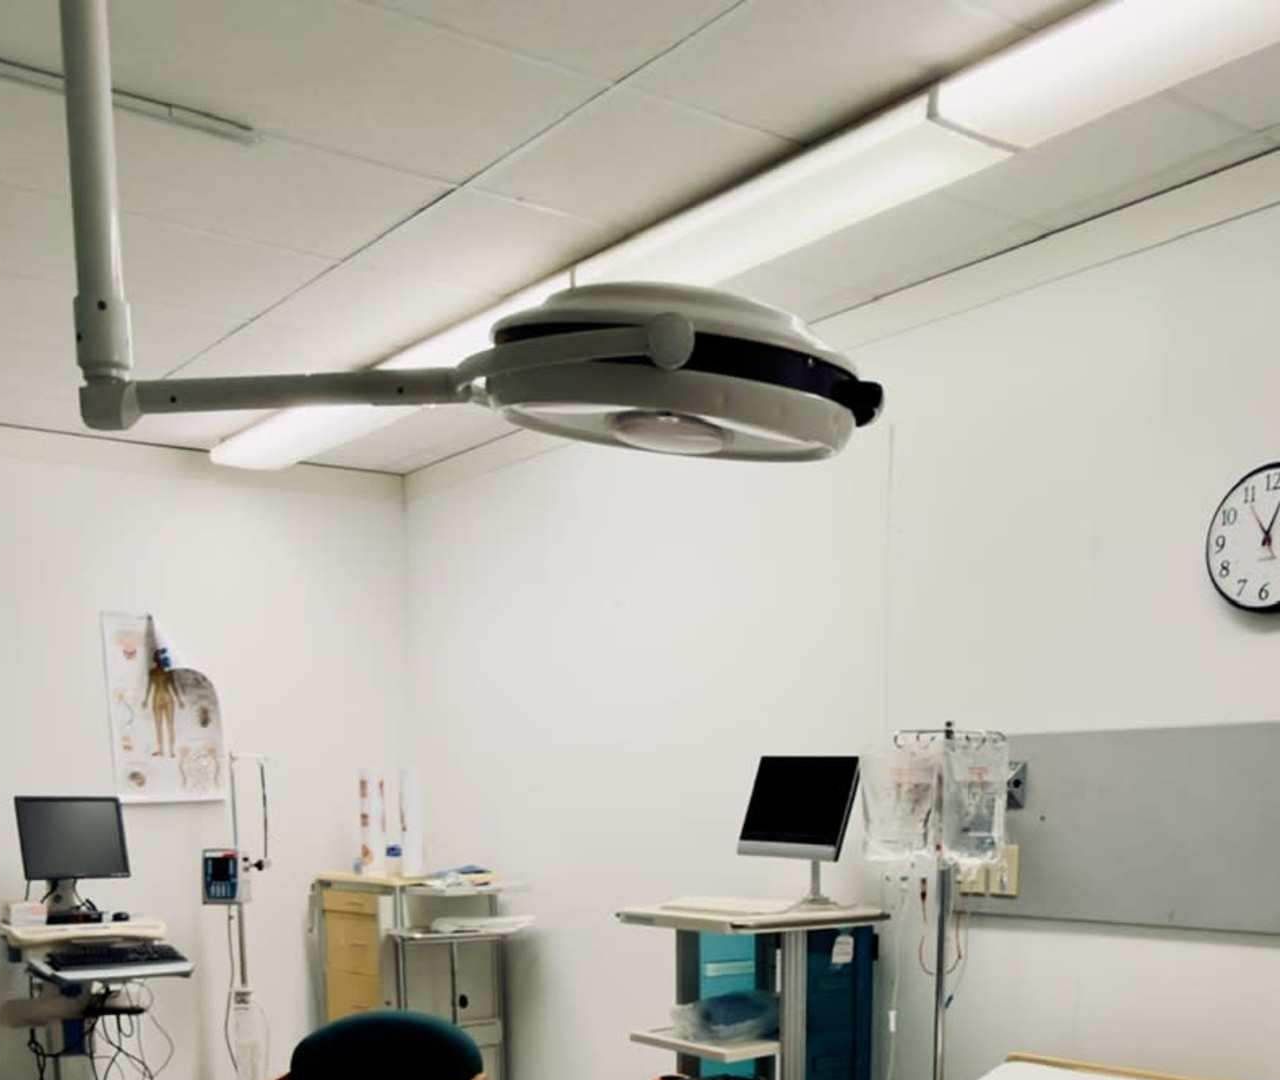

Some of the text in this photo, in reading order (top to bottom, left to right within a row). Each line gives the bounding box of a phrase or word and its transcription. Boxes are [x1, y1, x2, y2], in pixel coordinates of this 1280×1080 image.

[1244, 486, 1256, 504] 11
[1222, 508, 1238, 527] 10
[1215, 535, 1226, 554] 9
[1219, 560, 1231, 578] 8
[1236, 579, 1248, 597] 7
[1258, 582, 1270, 601] 6
